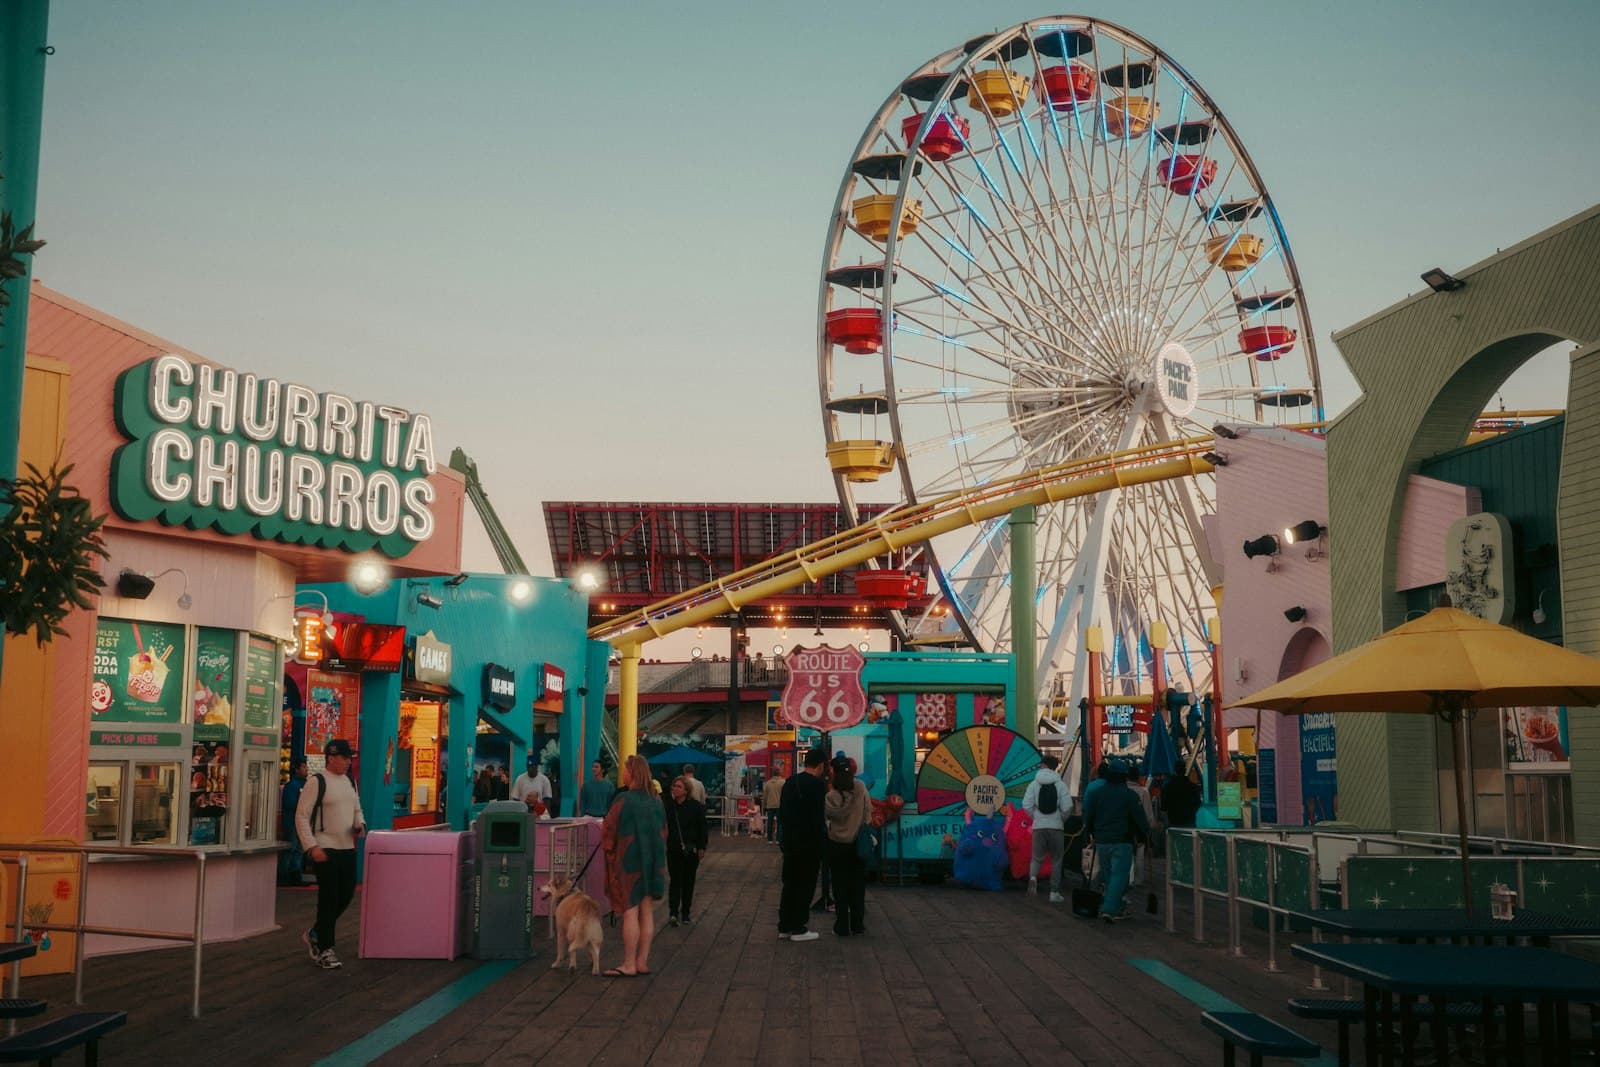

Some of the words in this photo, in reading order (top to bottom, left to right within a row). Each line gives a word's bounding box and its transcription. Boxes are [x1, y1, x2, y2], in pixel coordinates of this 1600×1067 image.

[1163, 358, 1192, 382] PACIFIC
[1168, 378, 1188, 400] PARK
[152, 354, 437, 475] CHURRITA
[149, 428, 435, 541] CHURROS
[97, 637, 119, 648] RST
[94, 655, 118, 666] ODA
[419, 646, 448, 673] GAMES
[798, 653, 851, 671] ROUTE
[93, 666, 118, 676] REAM
[808, 675, 841, 688] US
[800, 690, 850, 723] 66
[101, 733, 121, 744] PICK
[123, 734, 135, 744] UP
[137, 734, 159, 745] HERE
[973, 784, 998, 795] PACIFIC
[976, 795, 994, 804] PARK
[901, 824, 948, 839] WINNER
